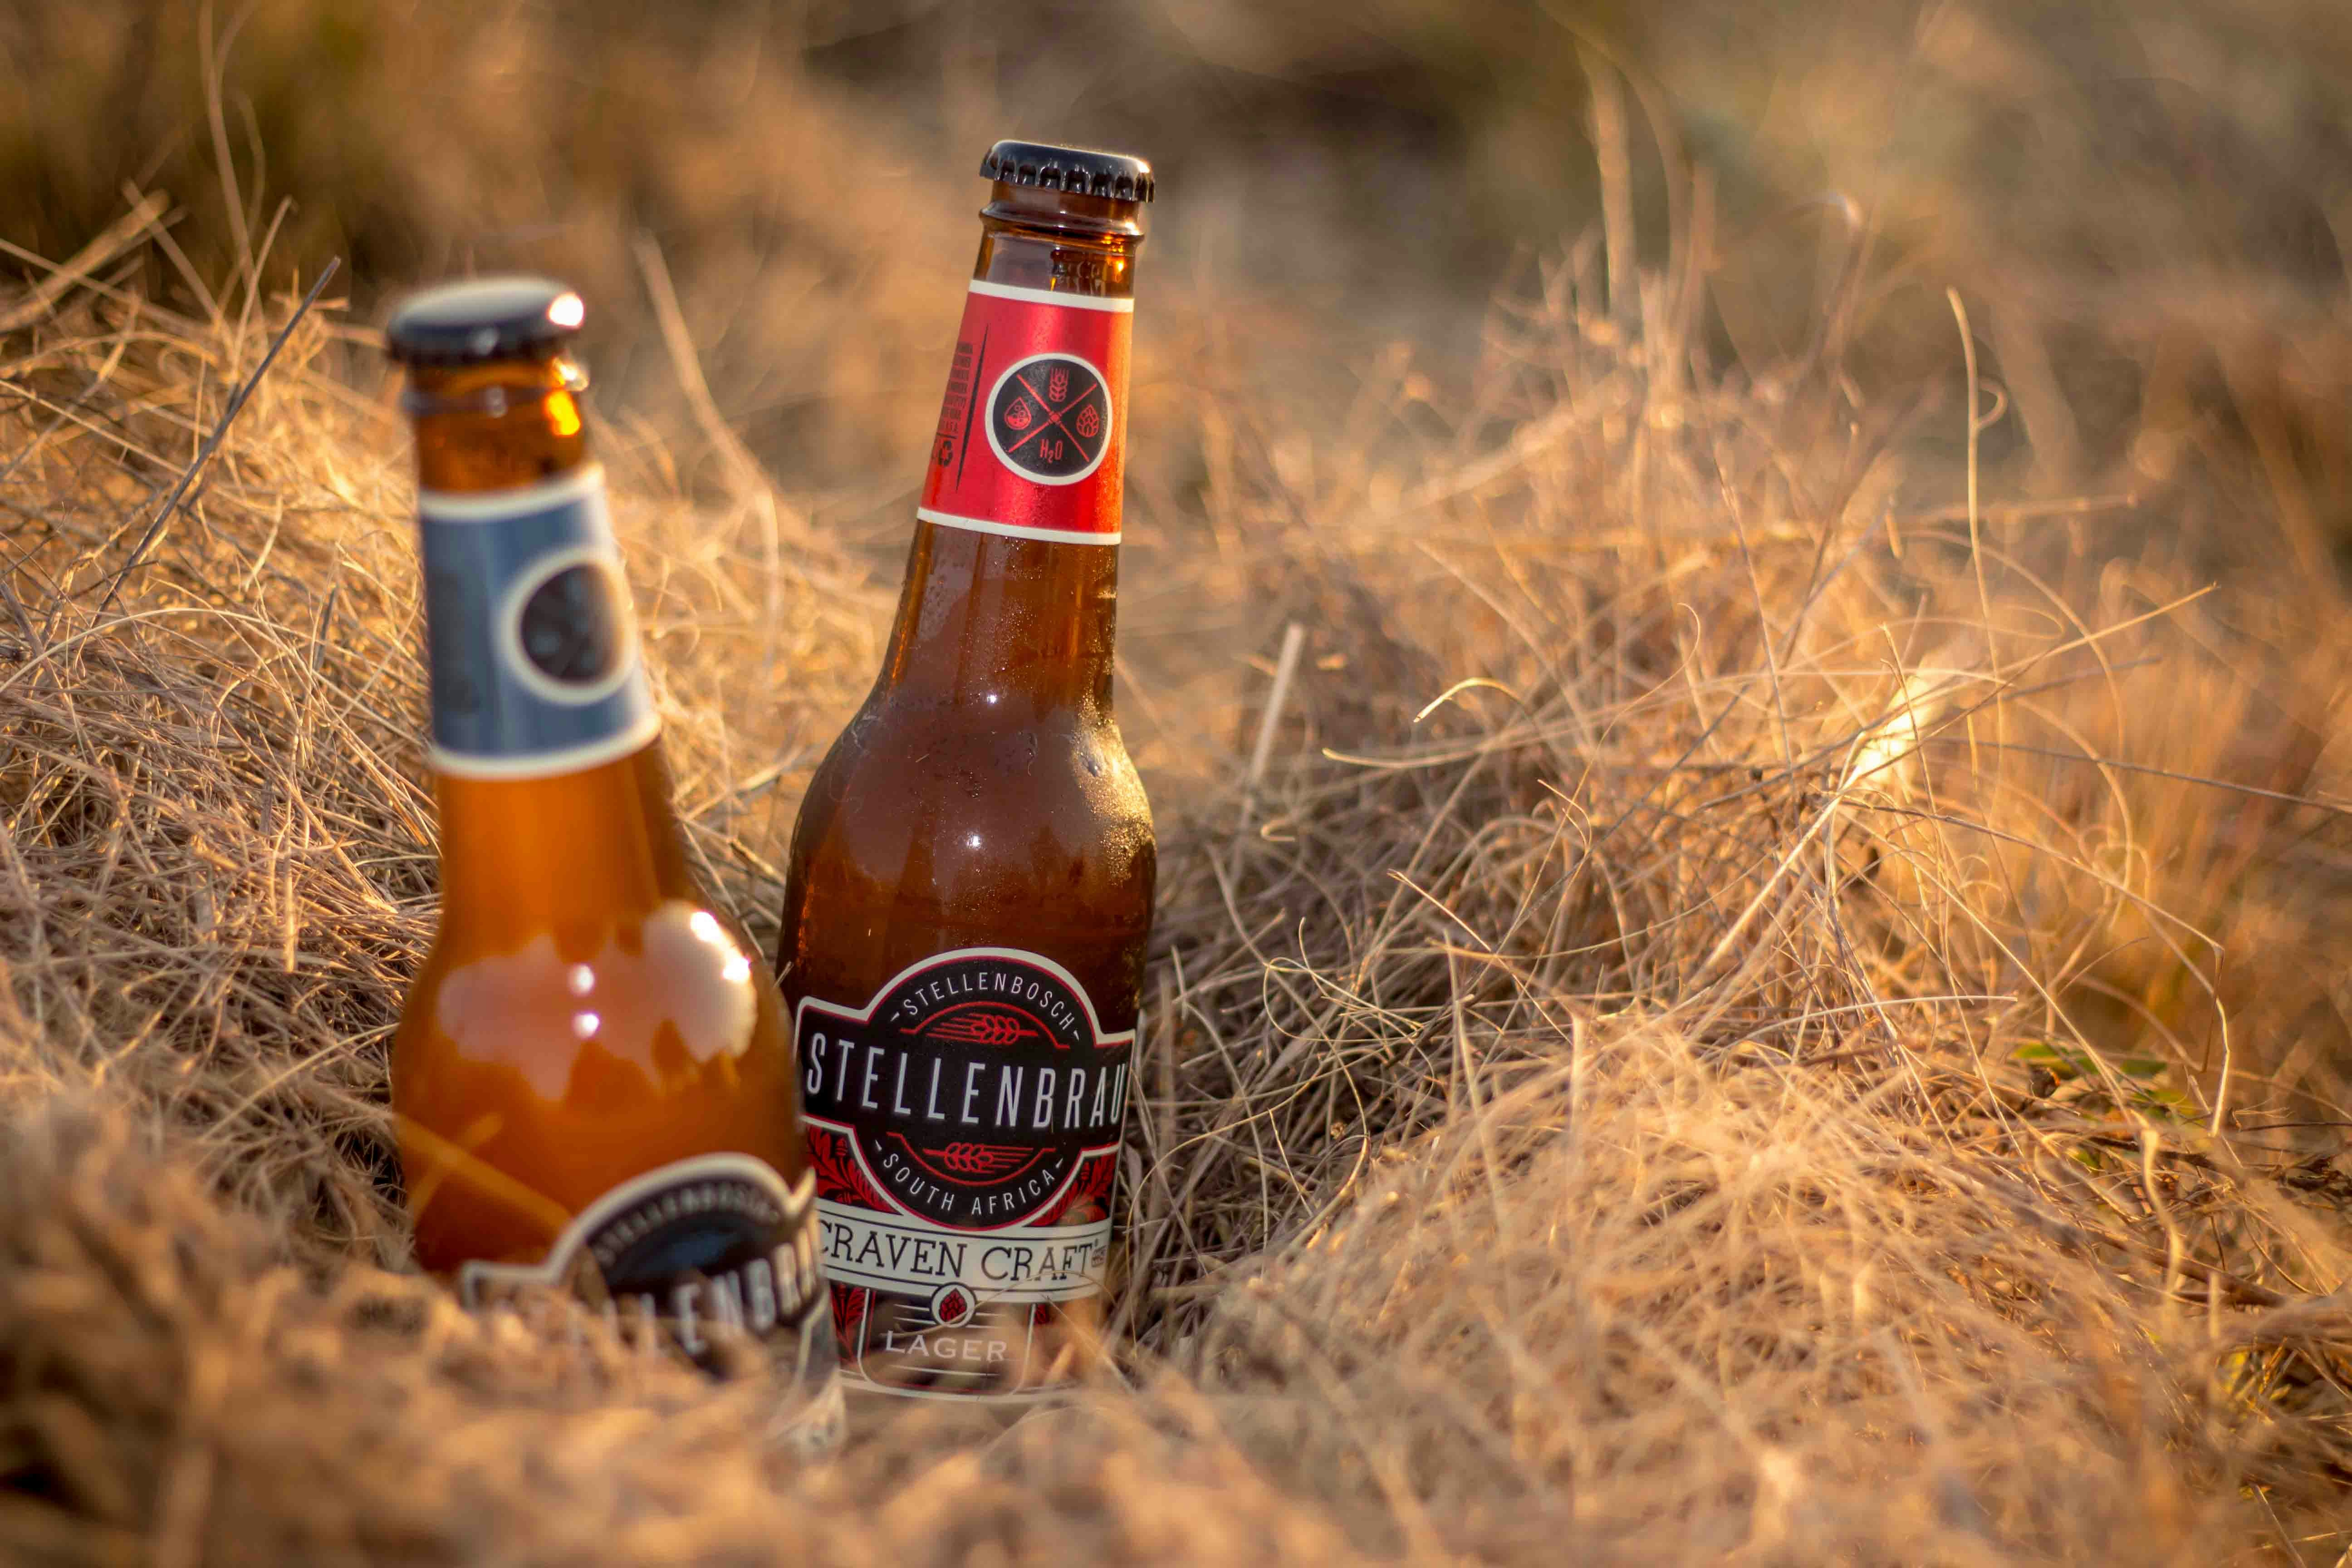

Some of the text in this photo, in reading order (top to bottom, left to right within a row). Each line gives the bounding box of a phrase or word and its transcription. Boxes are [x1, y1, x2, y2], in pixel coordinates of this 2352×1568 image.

[903, 972, 1075, 1030] STELLENBOSCH
[807, 1032, 1126, 1128] STELLENBRAU
[883, 1153, 1055, 1216] SOUTH AFRICA
[885, 1330, 1007, 1363] LAGER
